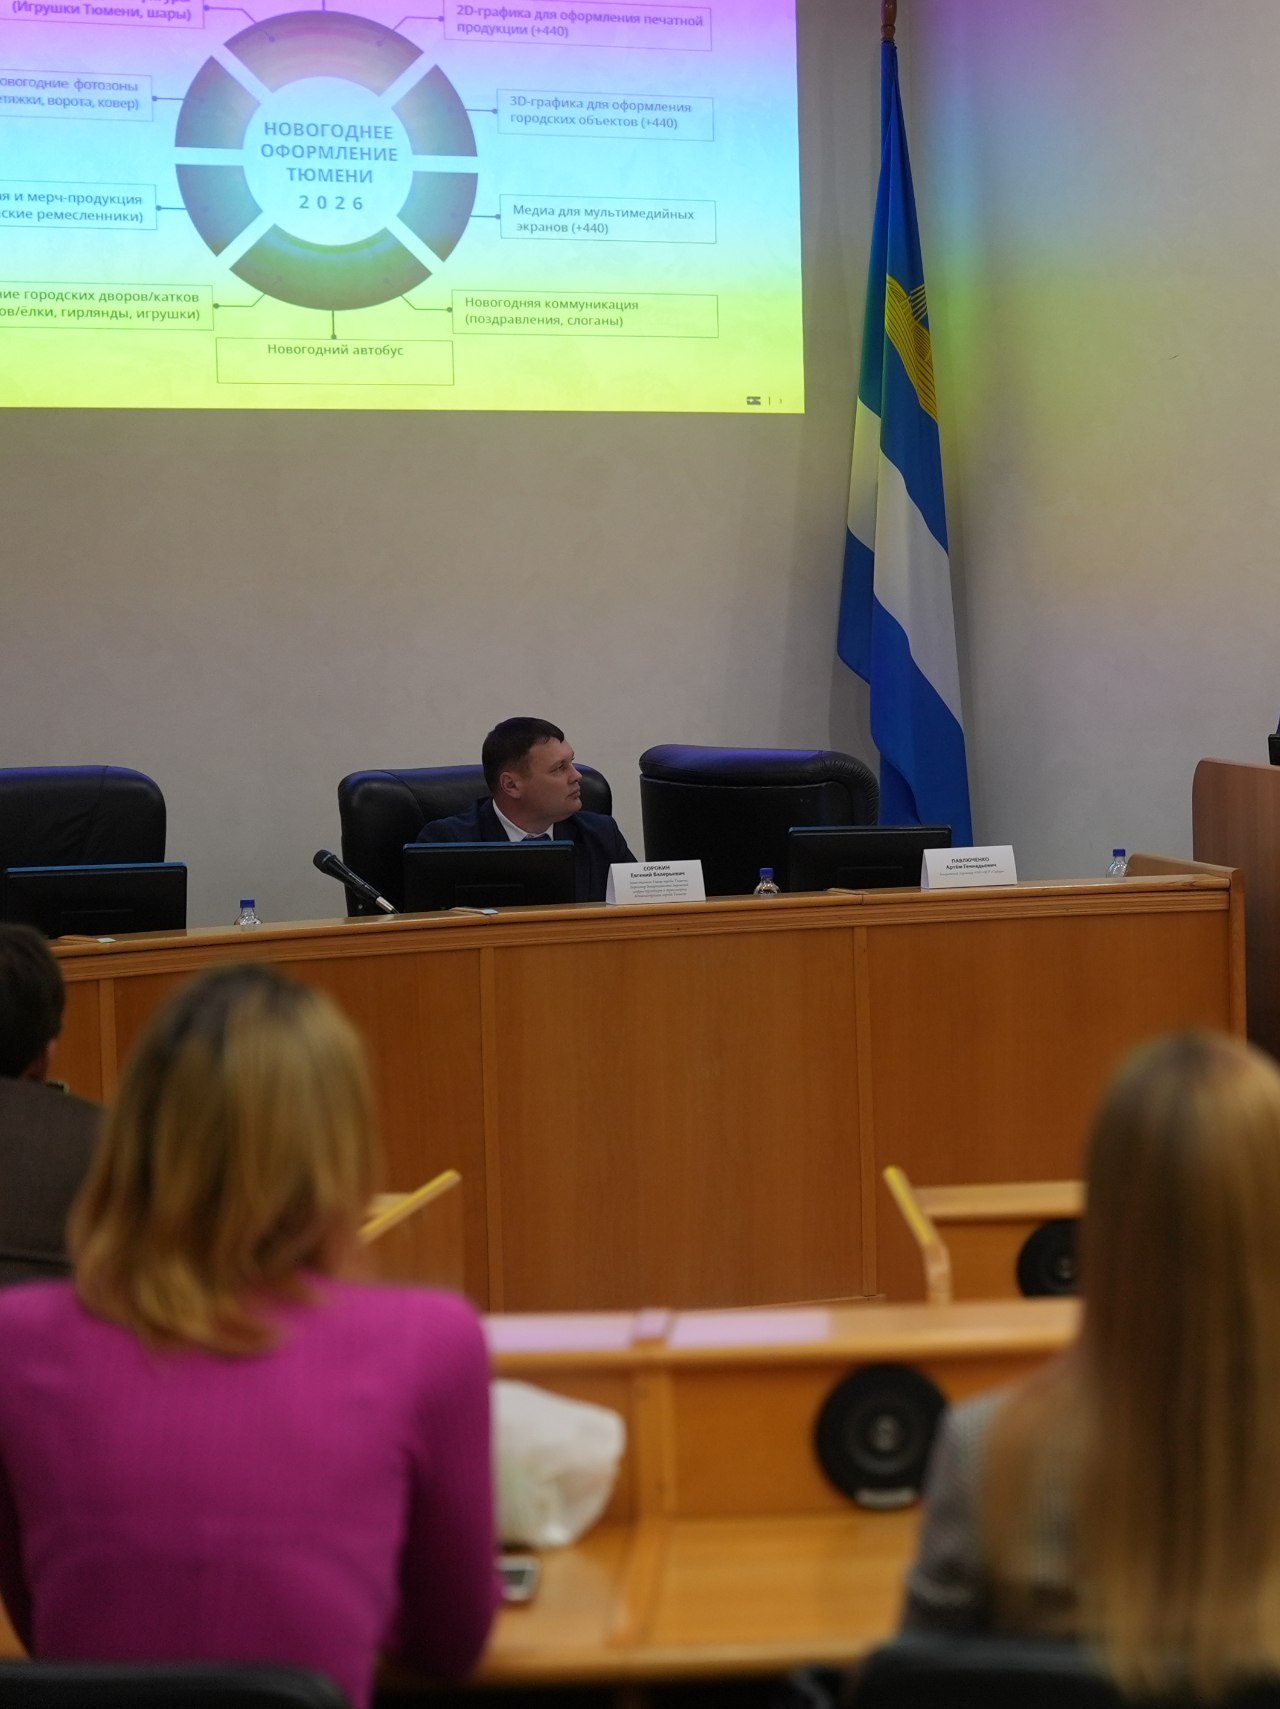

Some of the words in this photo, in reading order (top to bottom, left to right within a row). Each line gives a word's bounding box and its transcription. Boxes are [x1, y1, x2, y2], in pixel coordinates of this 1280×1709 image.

[12, 1, 80, 15] (Игрушки
[85, 4, 143, 18] Тюмени,
[147, 8, 192, 22] шары)
[456, 5, 531, 21] 2D-графика
[534, 9, 557, 22] для
[560, 11, 641, 26] оформления
[643, 13, 703, 28] печатной
[457, 23, 528, 37] продукции
[531, 25, 569, 39] (+440)
[74, 78, 138, 92] фотозоны
[47, 96, 95, 108] ворота,
[98, 98, 139, 111] ковер)
[509, 96, 583, 112] 3D-графика
[586, 98, 609, 112] для
[612, 100, 692, 115] оформления
[510, 115, 576, 128] городских
[579, 115, 638, 129] объектов
[641, 117, 678, 130] (+440)
[264, 121, 394, 142] НОВОГОДНЕЕ
[260, 143, 398, 162] ОФОРМЛЕНИЕ
[286, 167, 373, 184] ТЮМЕНИ
[14, 193, 23, 202] и
[28, 193, 142, 206] мерч-продукция
[37, 211, 143, 223] ремесленники)
[513, 205, 555, 219] Медиа
[558, 207, 581, 219] для
[584, 207, 695, 222] мультимедийных
[516, 223, 569, 236] экранов
[571, 222, 609, 236] (+440)
[24, 291, 95, 303] городских
[99, 291, 199, 304] дворов/катков
[465, 297, 541, 312] Новогодняя
[545, 299, 639, 313] коммуникация
[61, 307, 132, 319] гирлянды,
[136, 308, 200, 322] игрушки)
[465, 313, 564, 329] (поздравления,
[567, 314, 624, 329] слоганы)
[267, 343, 349, 356] Новогодний
[353, 345, 404, 357] автобус
